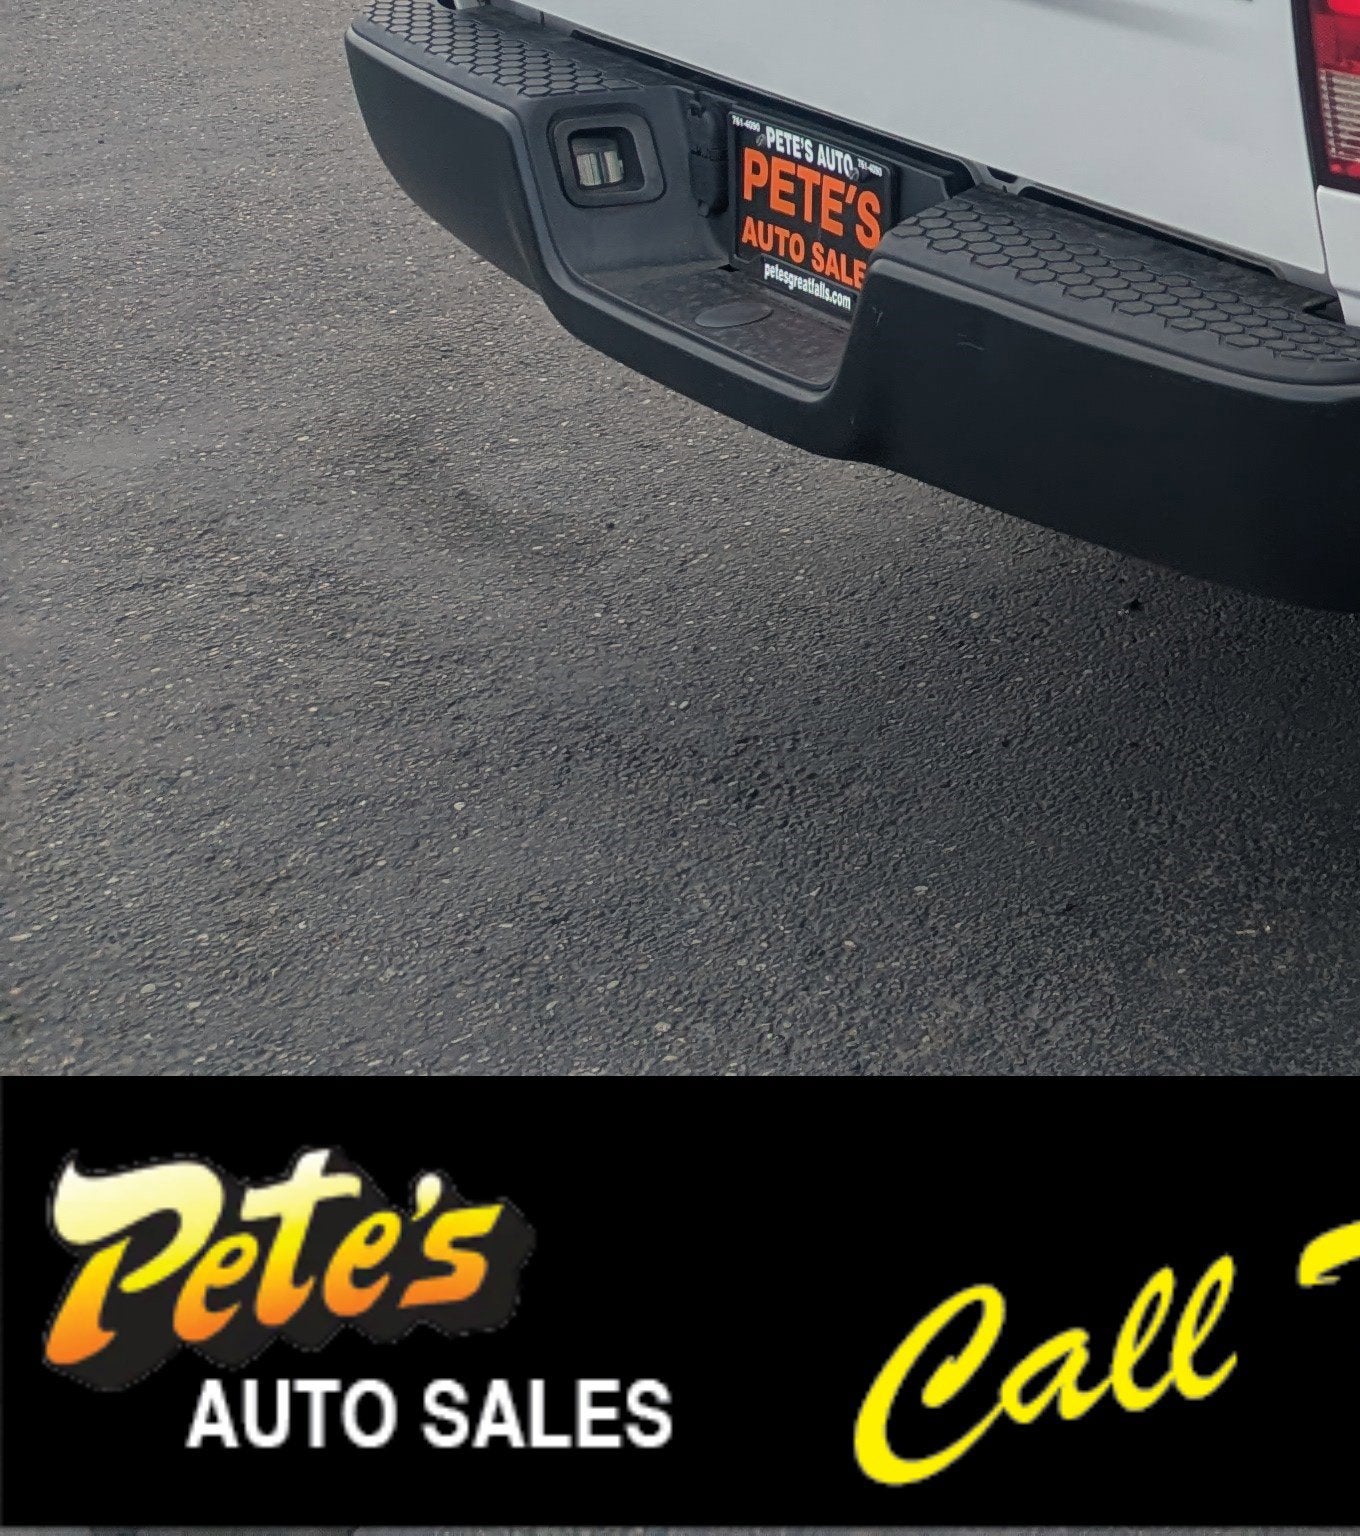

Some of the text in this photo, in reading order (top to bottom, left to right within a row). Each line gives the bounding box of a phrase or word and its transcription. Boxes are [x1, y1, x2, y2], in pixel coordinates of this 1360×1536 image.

[765, 125, 857, 180] PETE'S AUTO
[742, 146, 882, 250] PETE'S
[741, 216, 868, 290] AUTO SALE
[763, 264, 851, 311] petesgreatfalls.com
